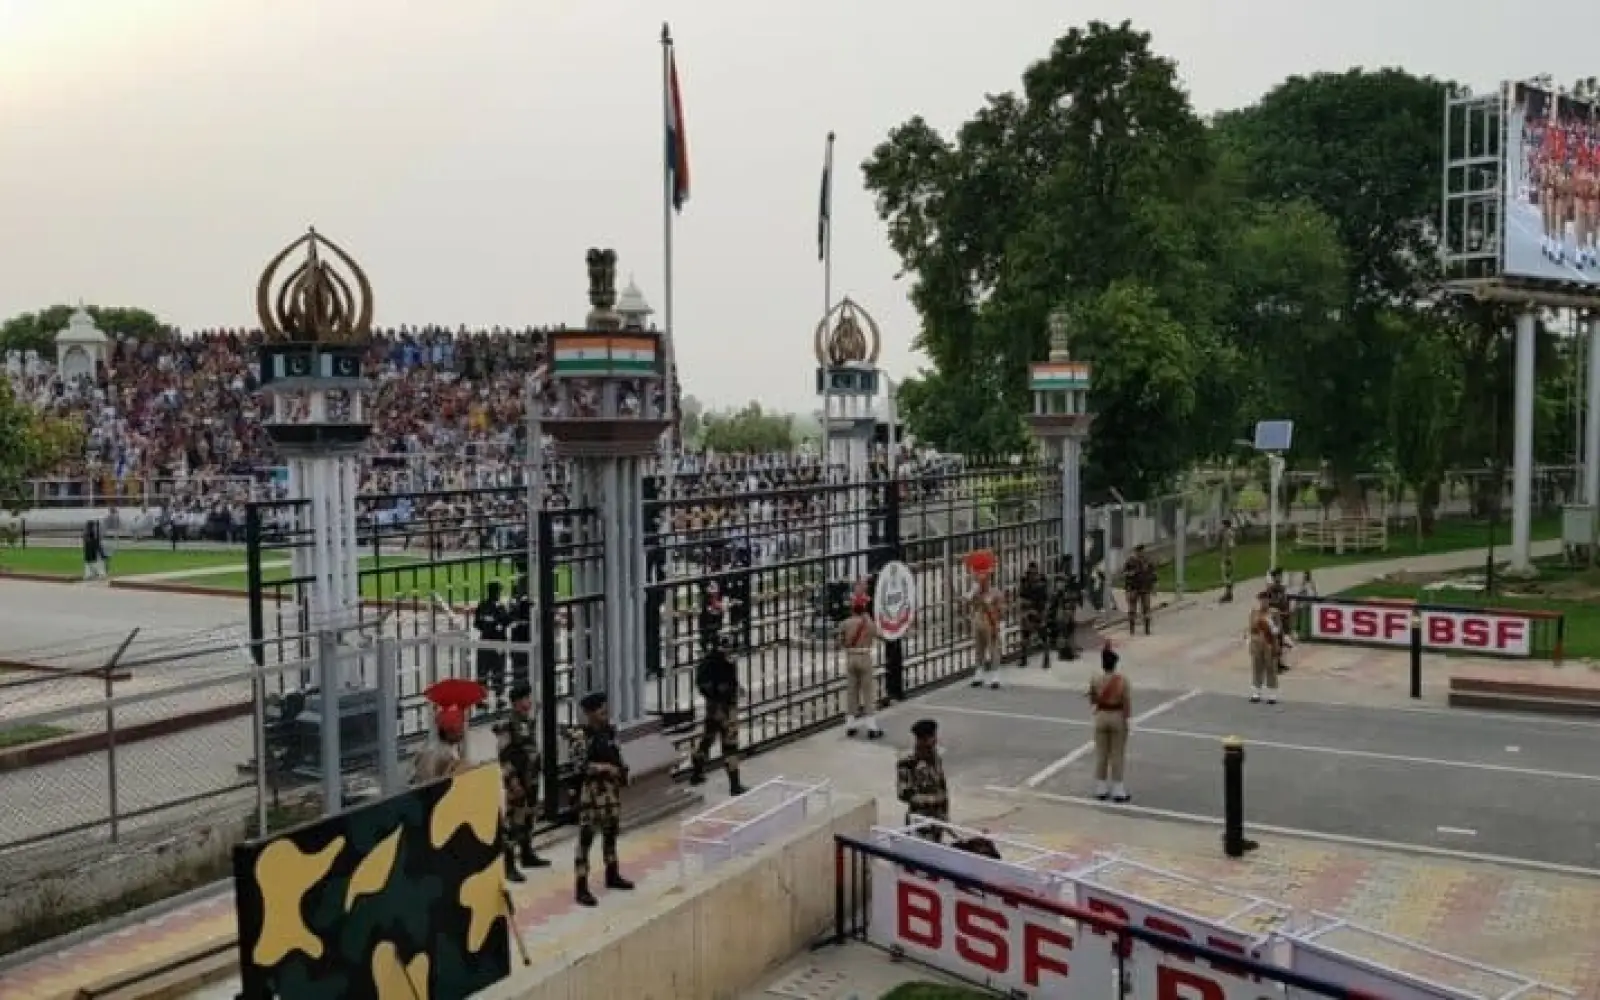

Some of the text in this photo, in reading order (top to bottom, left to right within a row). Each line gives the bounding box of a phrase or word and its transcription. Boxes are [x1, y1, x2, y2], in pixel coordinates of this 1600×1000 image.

[1319, 607, 1408, 639] BSF
[1428, 616, 1524, 648] BSF
[897, 880, 1073, 986] BSF
